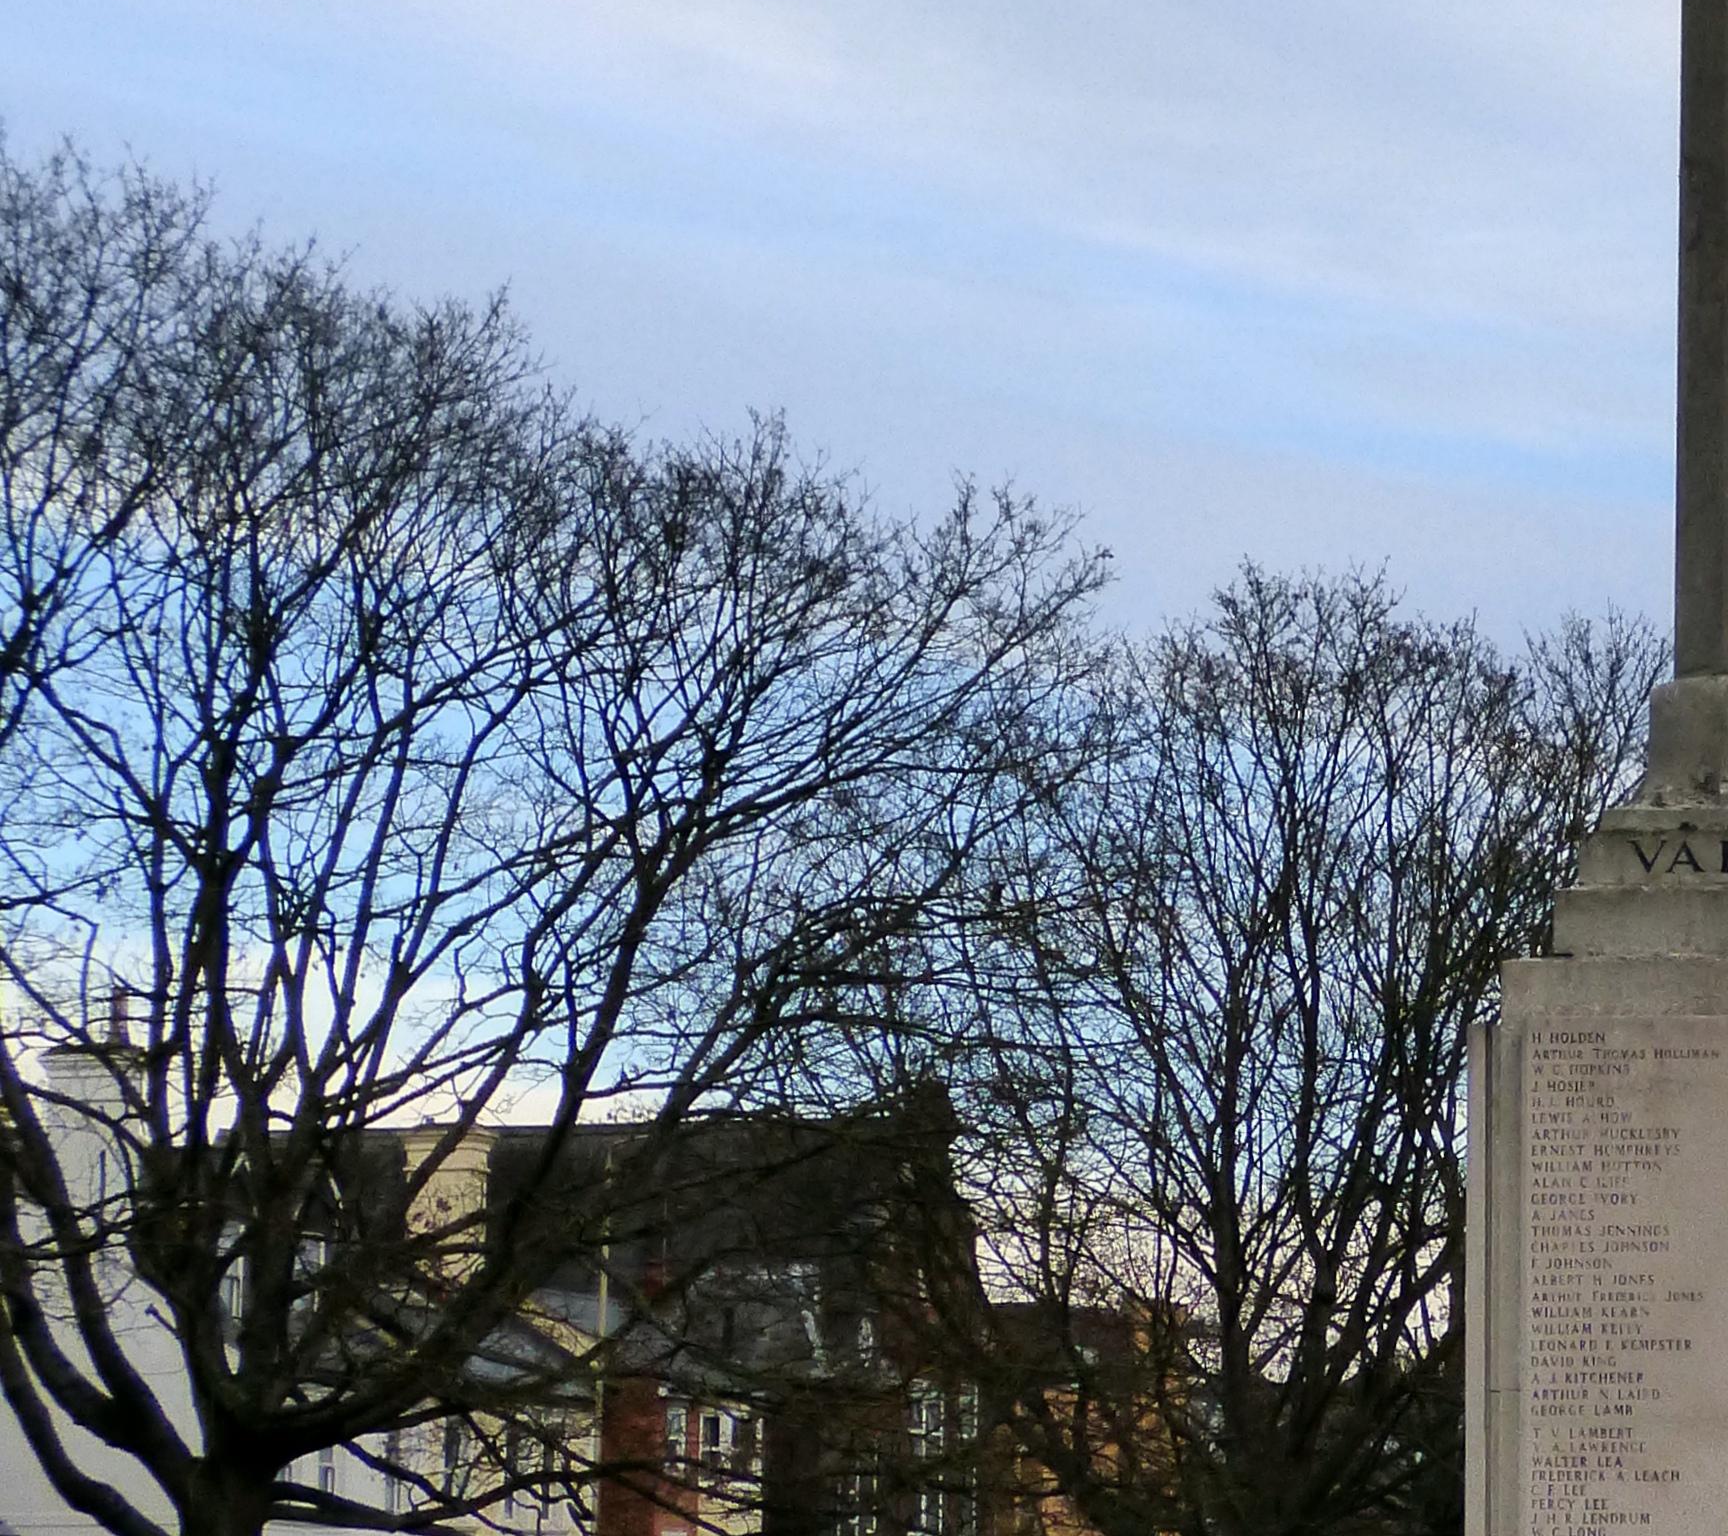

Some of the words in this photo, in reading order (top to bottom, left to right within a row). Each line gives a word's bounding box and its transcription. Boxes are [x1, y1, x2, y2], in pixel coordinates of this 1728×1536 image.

[1550, 1033, 1605, 1044] HOLDEN
[1592, 1049, 1645, 1060] THOMAS
[1531, 1145, 1584, 1156] ERNEST
[1532, 1161, 1592, 1172] WILLIAM
[1531, 1193, 1585, 1205] GEORGE
[1532, 1225, 1591, 1236] THOMAS
[1600, 1225, 1670, 1236] JENNINGS
[1603, 1241, 1669, 1252] JOHNSON
[1546, 1258, 1612, 1269] JOHNSON
[1532, 1274, 1584, 1285] ALBERT
[1613, 1274, 1654, 1285] JONES
[1532, 1307, 1591, 1318] WILLIAM
[1532, 1323, 1591, 1335] WILLIAM
[1531, 1340, 1597, 1351] LEONARD
[1531, 1356, 1574, 1367] DAVID
[1565, 1372, 1643, 1384] KITCHENER
[1533, 1389, 1589, 1400] ARTHUR
[1531, 1405, 1584, 1416] GEORGE
[1594, 1405, 1633, 1416] LAMB
[1570, 1428, 1632, 1438] LAMBERT
[1532, 1457, 1587, 1468] WALTER
[1597, 1457, 1622, 1468] LEA
[1532, 1471, 1605, 1481] FREDERICK
[1635, 1471, 1680, 1481] LEACH
[1565, 1485, 1586, 1496] LEE
[1585, 1499, 1608, 1510] LEE
[1583, 1513, 1650, 1524] LENDRUM
